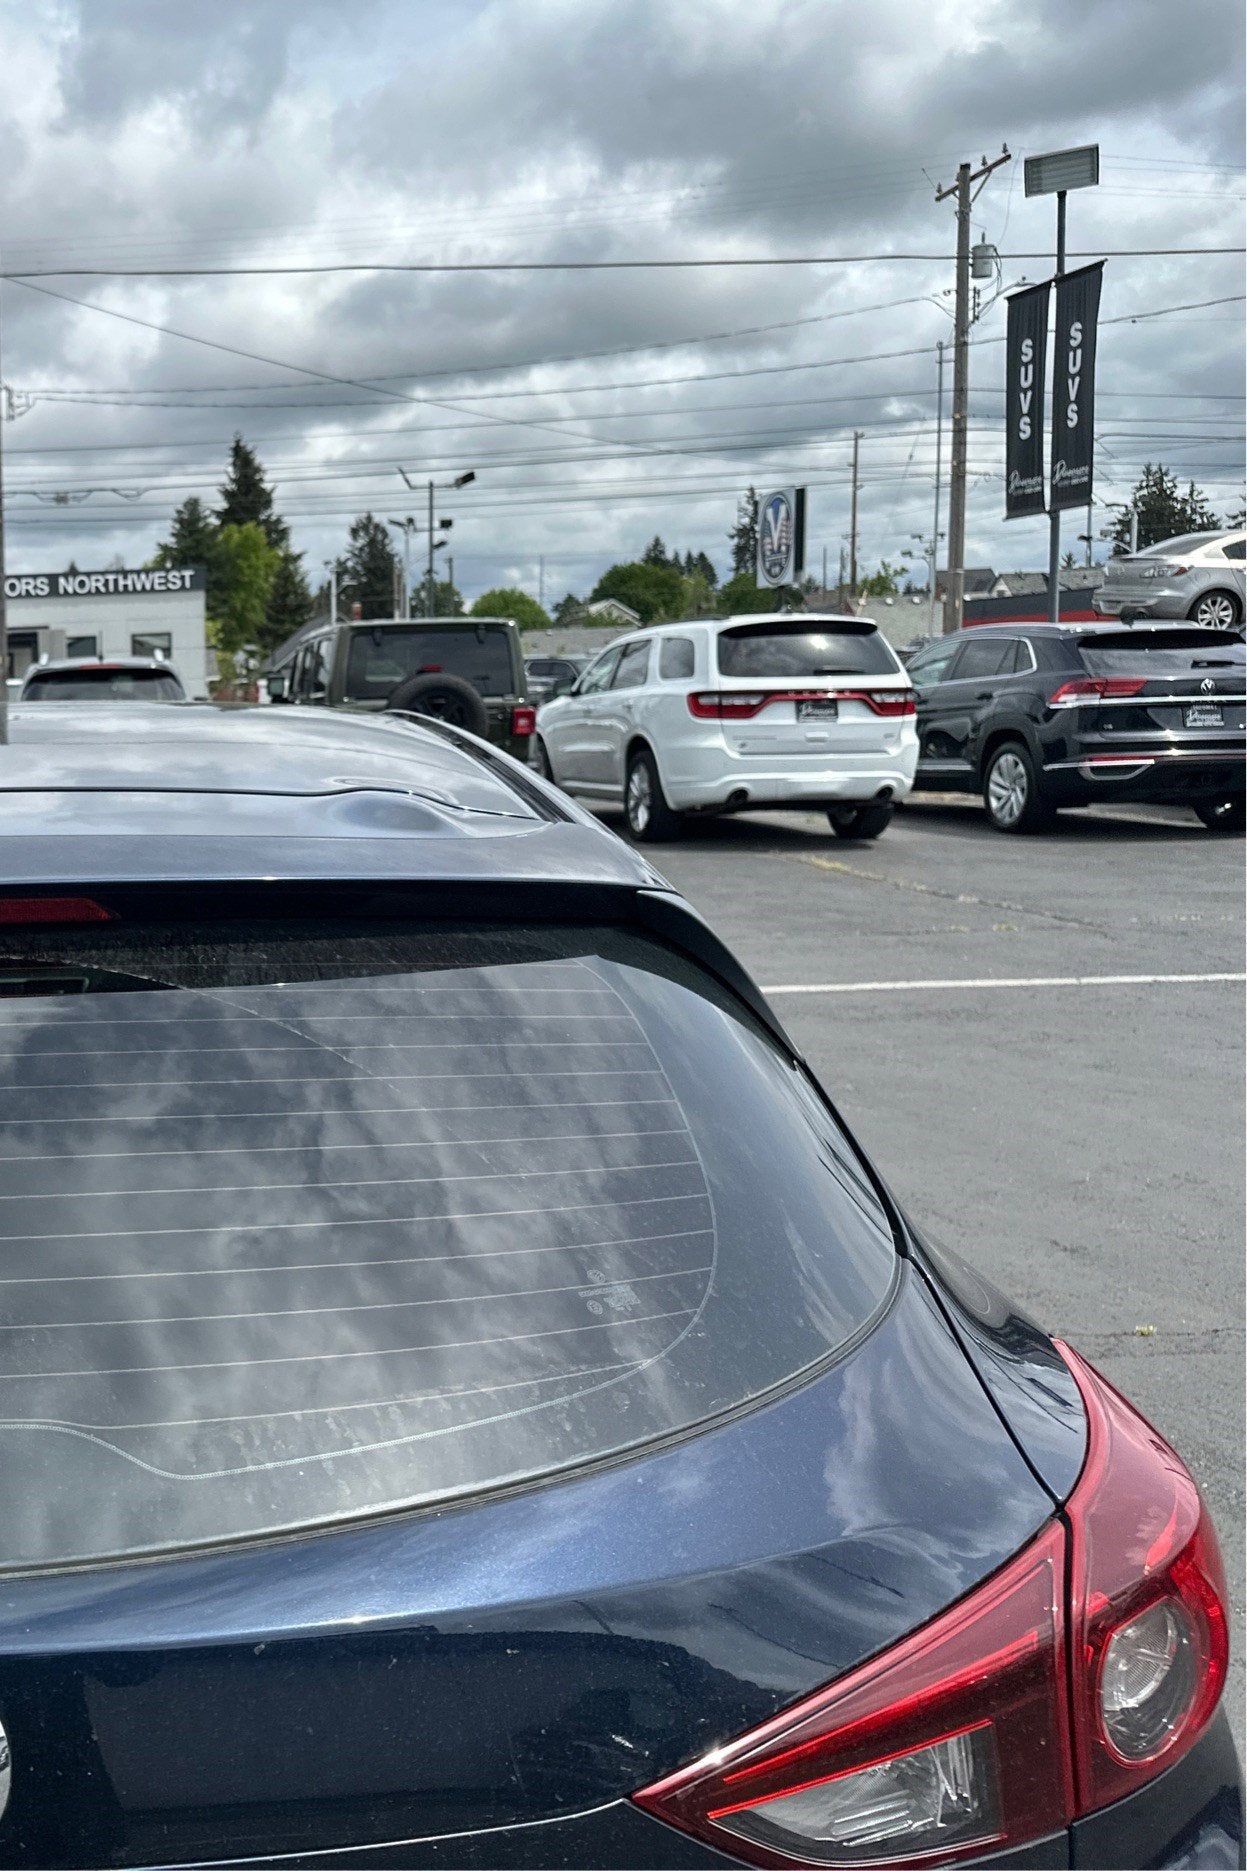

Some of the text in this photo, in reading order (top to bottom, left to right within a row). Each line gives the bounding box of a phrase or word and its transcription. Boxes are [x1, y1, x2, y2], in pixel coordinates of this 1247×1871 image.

[1018, 338, 1034, 441] SUVS
[1066, 321, 1083, 429] SUVS
[58, 569, 195, 596] NORTHWEST
